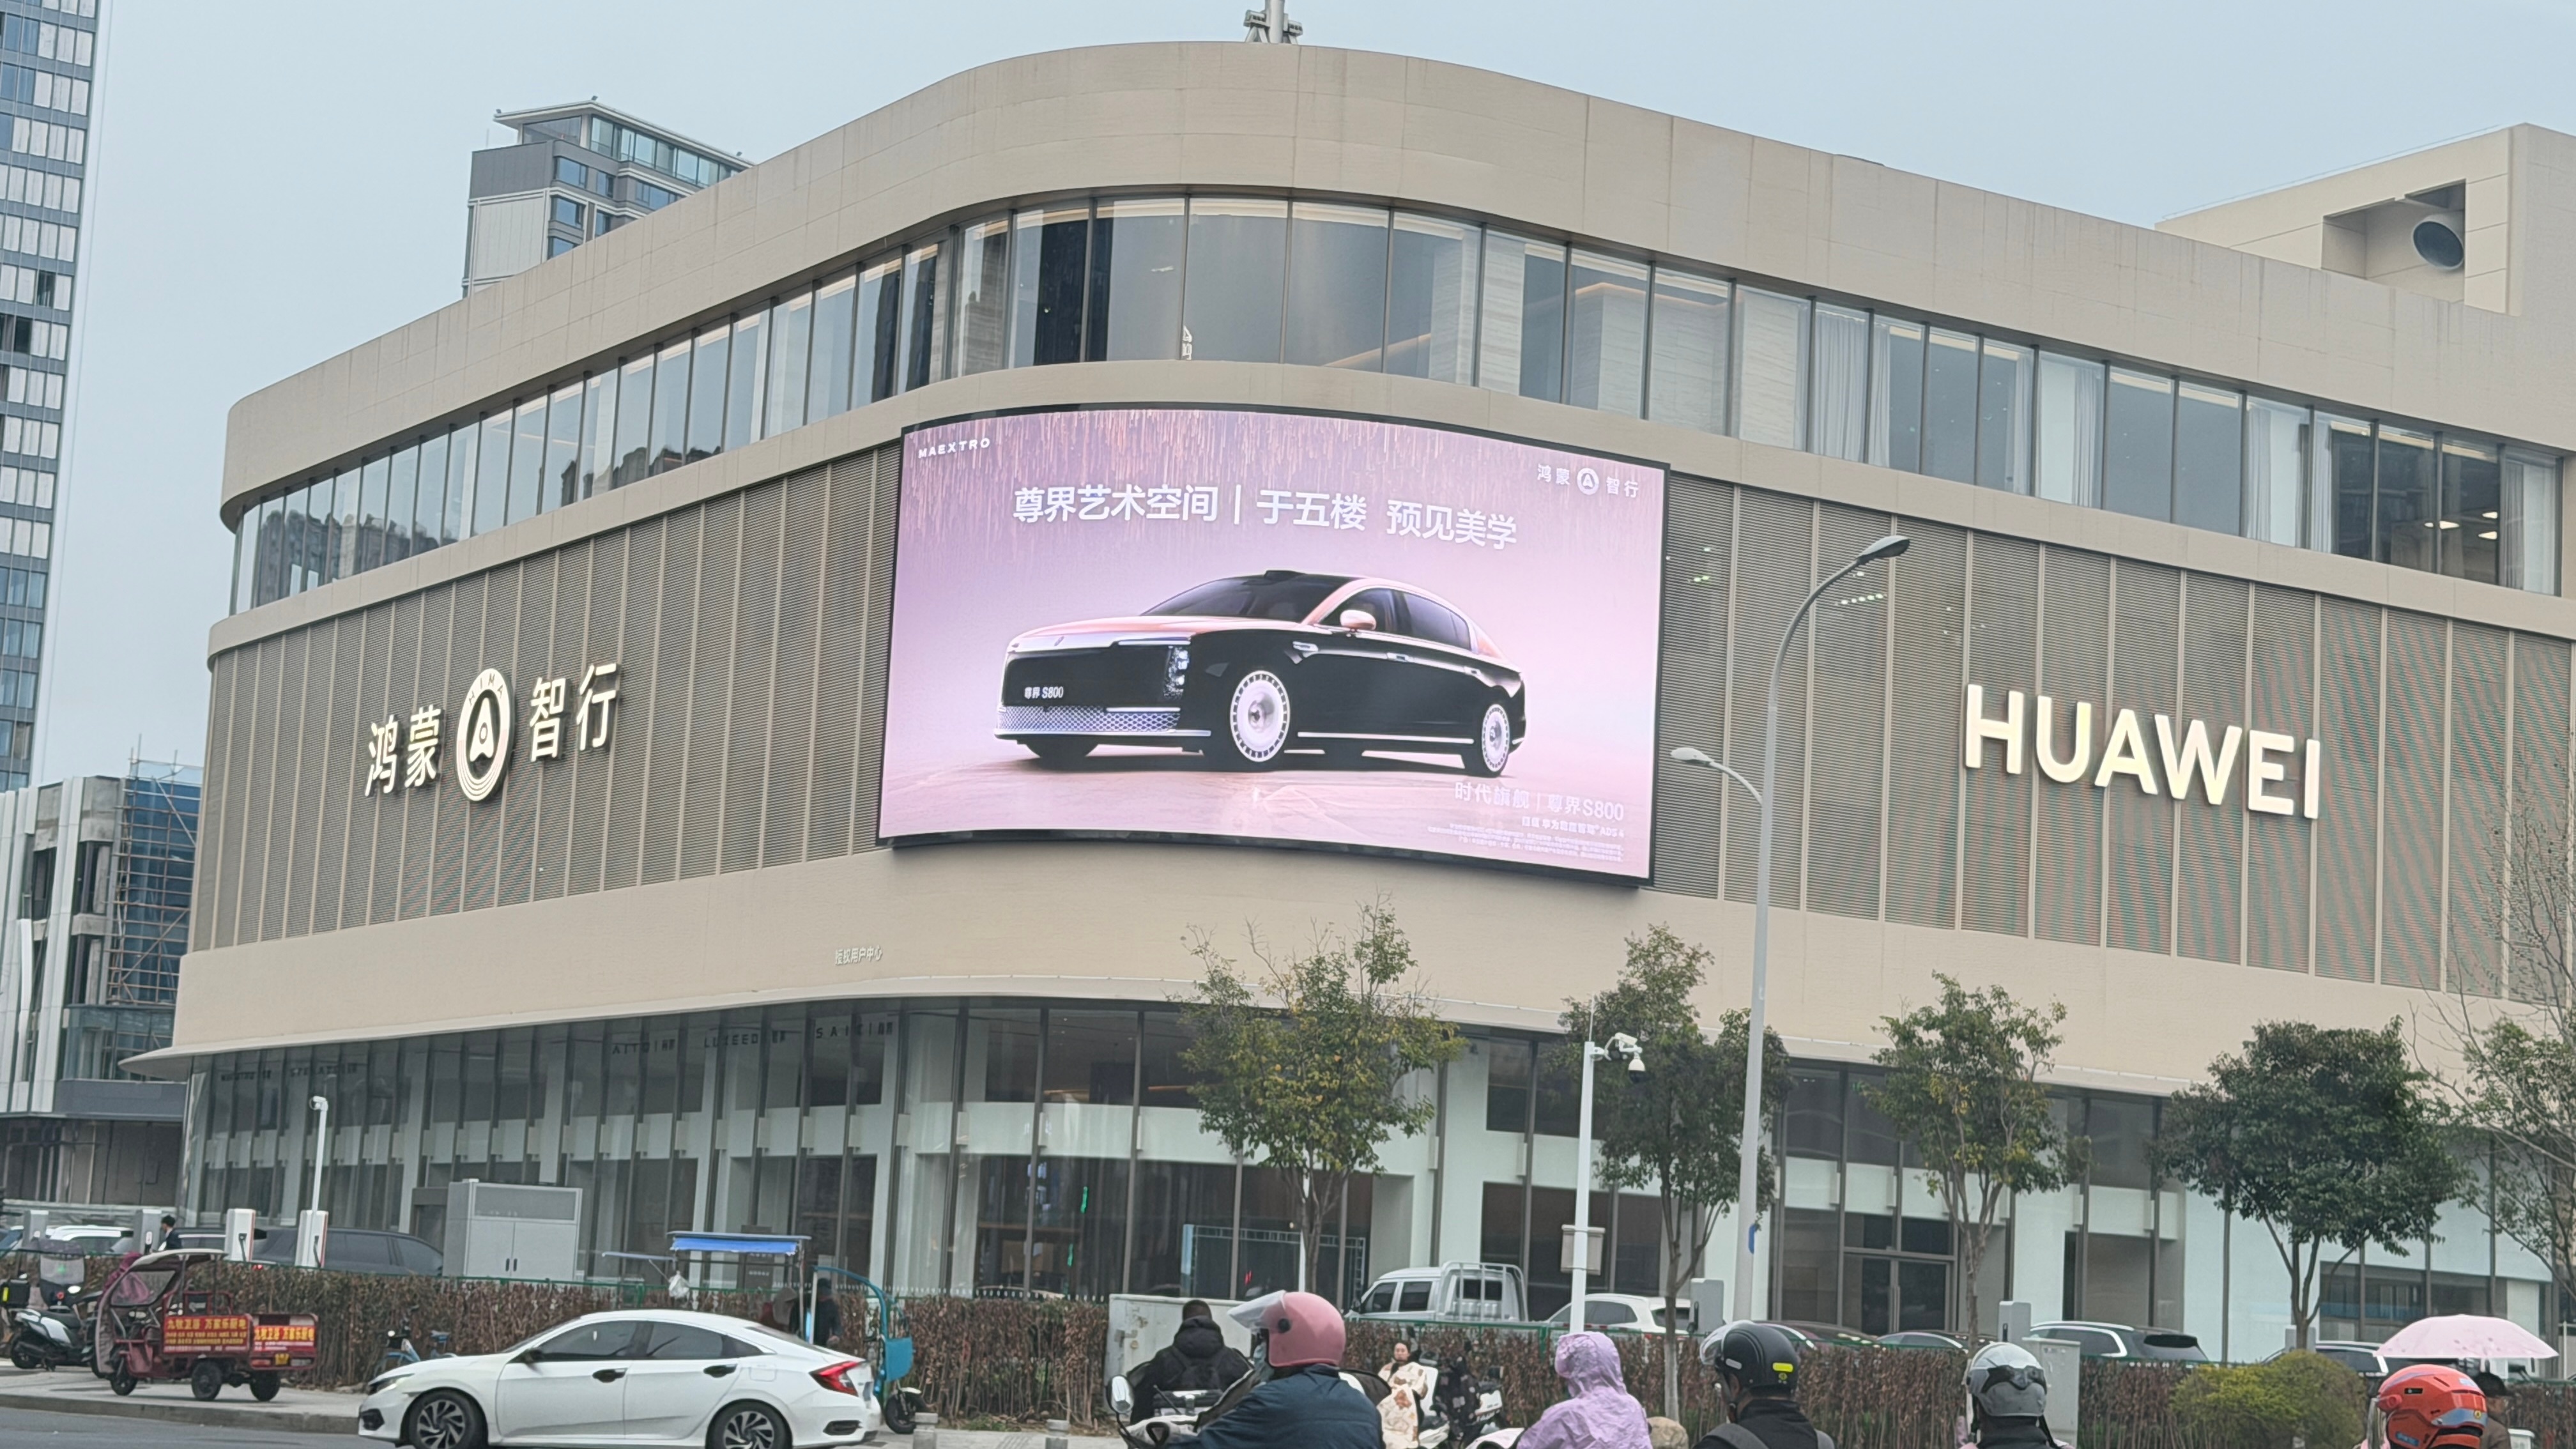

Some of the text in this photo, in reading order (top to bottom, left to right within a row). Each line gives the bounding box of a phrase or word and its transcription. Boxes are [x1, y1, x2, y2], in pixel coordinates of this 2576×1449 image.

[918, 438, 990, 459] MAEXTRO
[1537, 463, 1639, 498] 鸿蒙 智行
[1013, 484, 1517, 550] 尊界艺术空间 于五楼 预见美学
[1041, 686, 1064, 699] S800
[365, 663, 619, 797] 鸿蒙 智行
[1965, 683, 2320, 820] HUAWEI
[1454, 781, 1530, 809] 时代旗舰
[1546, 795, 1625, 822] 尊界S800
